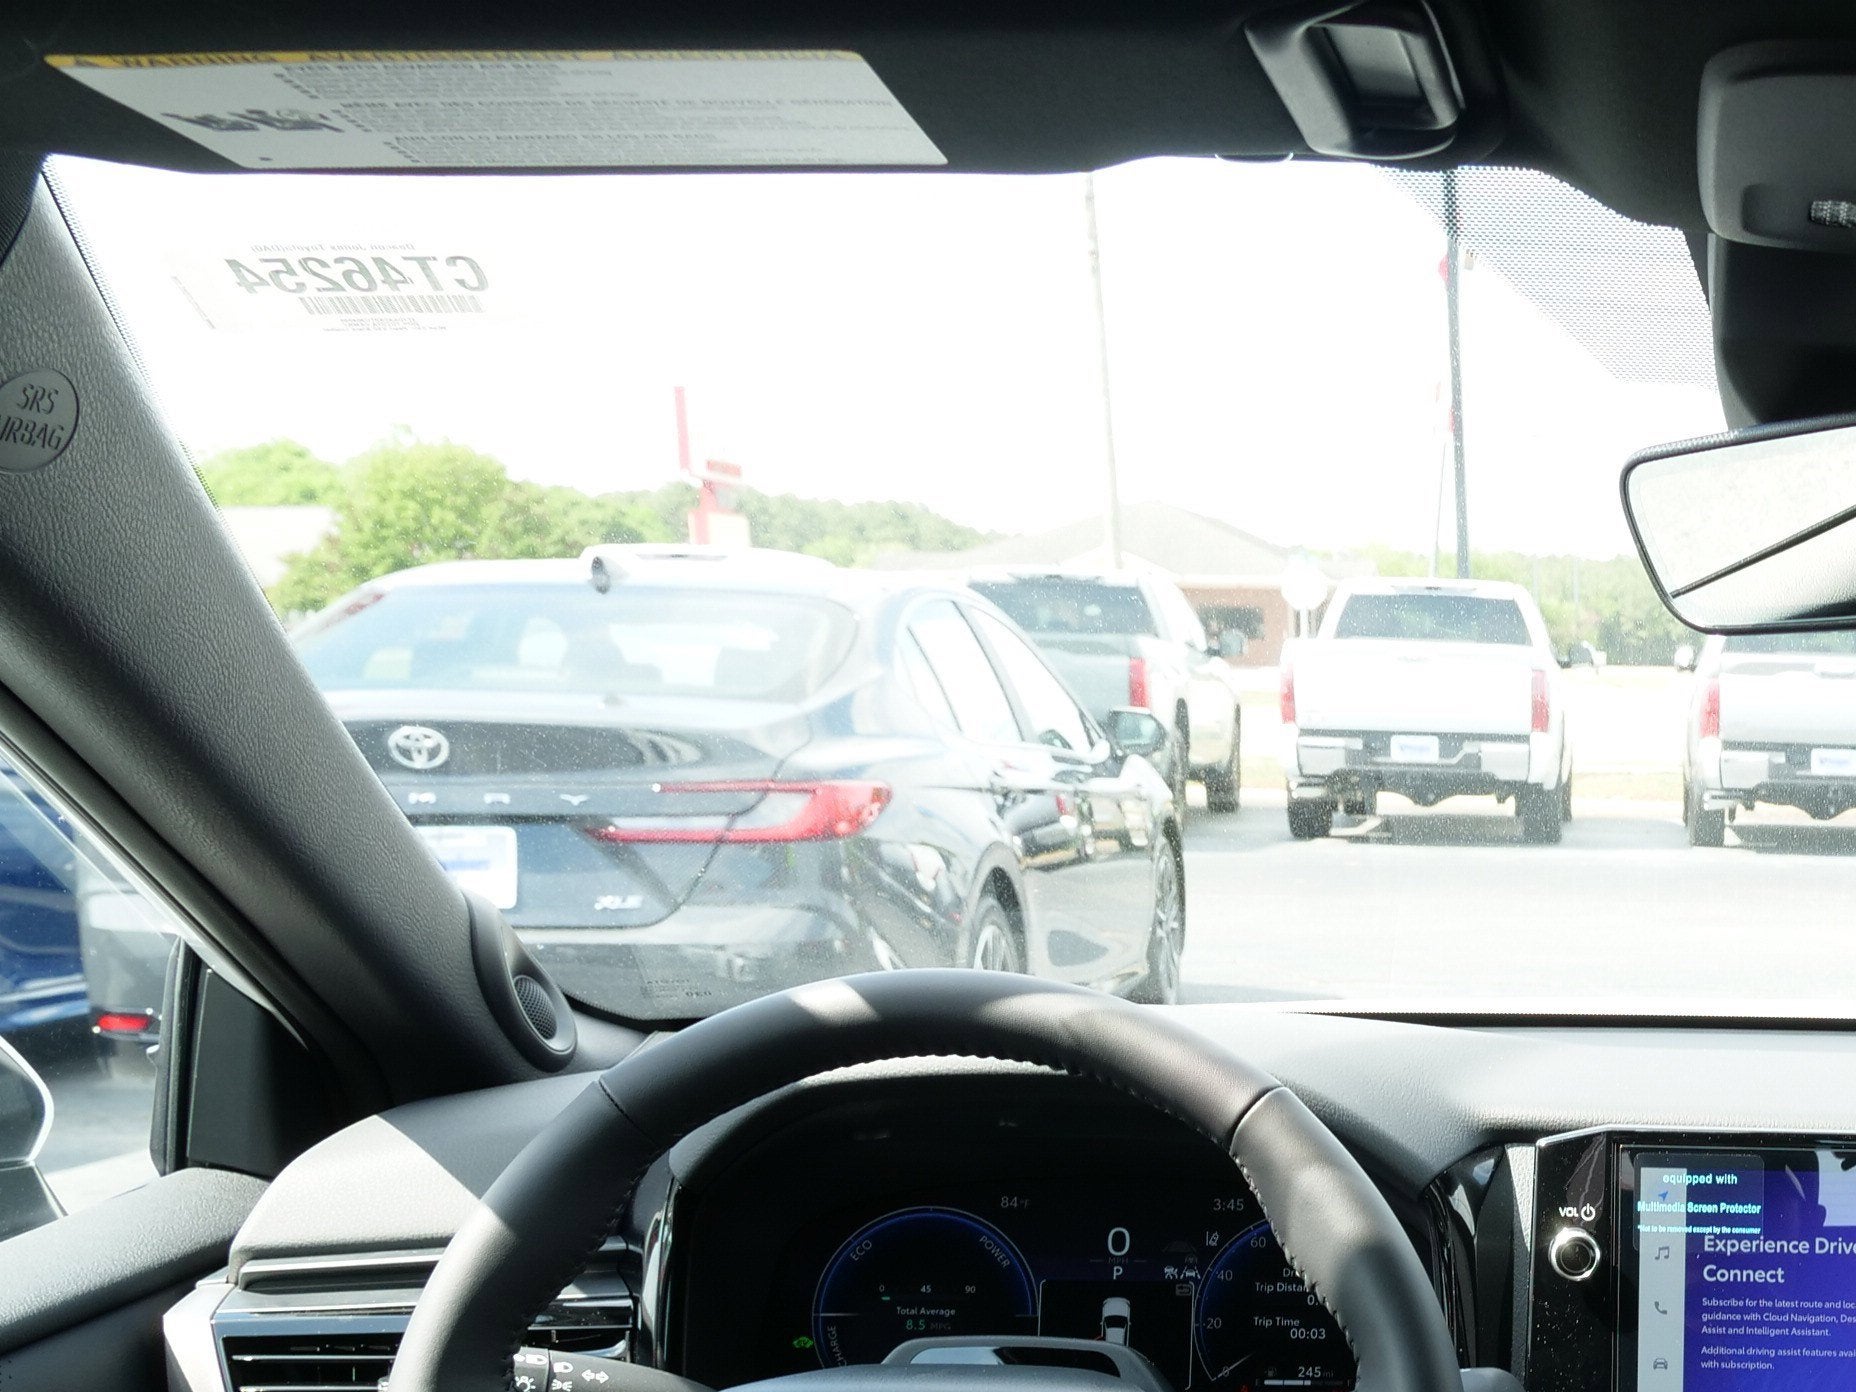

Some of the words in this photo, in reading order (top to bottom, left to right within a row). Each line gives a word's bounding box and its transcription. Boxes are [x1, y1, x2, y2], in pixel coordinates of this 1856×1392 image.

[16, 383, 60, 415] SRS
[408, 791, 590, 806] MRY
[1662, 1173, 1713, 1186] equipped
[1715, 1173, 1738, 1184] with
[1213, 1198, 1245, 1211] 3:45
[1637, 1201, 1686, 1213] Multimedia
[1687, 1202, 1719, 1213] Screen
[1719, 1202, 1762, 1214] Protector
[1559, 1206, 1578, 1218] VOL
[1107, 1226, 1131, 1256] 0
[1250, 1237, 1267, 1249] 60
[1704, 1235, 1810, 1256] Experience
[850, 1238, 873, 1262] ECO
[978, 1234, 1011, 1270] POWER
[1112, 1265, 1123, 1280] P
[1217, 1270, 1233, 1282] 40
[1702, 1264, 1785, 1283] Connect
[920, 1284, 932, 1294] 45
[964, 1284, 976, 1294] 90
[1255, 1281, 1275, 1294] Trip
[1702, 1297, 1744, 1307] Subscribe
[1746, 1297, 1757, 1307] for
[1759, 1298, 1773, 1308] the
[1774, 1299, 1799, 1308] latest
[1801, 1300, 1823, 1309] route
[1824, 1300, 1841, 1309] and
[896, 1305, 918, 1316] Total
[920, 1307, 956, 1320] Average
[1701, 1311, 1742, 1322] guidance
[1743, 1312, 1761, 1321] with
[1763, 1312, 1789, 1322] Cloud
[1791, 1313, 1838, 1324] Navigation,
[905, 1319, 926, 1331] 8.5
[1206, 1318, 1223, 1330] 20
[1253, 1316, 1273, 1329] Trip
[1274, 1316, 1301, 1328] Time
[1290, 1328, 1327, 1340] 00:03
[1701, 1325, 1726, 1335] Assist
[1727, 1325, 1745, 1335] and
[1746, 1326, 1789, 1338] Intelligent
[1791, 1327, 1832, 1337] Assistant.
[1701, 1346, 1745, 1356] Additional
[1746, 1346, 1775, 1358] driving
[1777, 1348, 1801, 1357] assist
[1802, 1348, 1837, 1358] features
[1297, 1366, 1323, 1378] 245
[1701, 1360, 1719, 1369] with
[1720, 1360, 1775, 1371] subscription.
